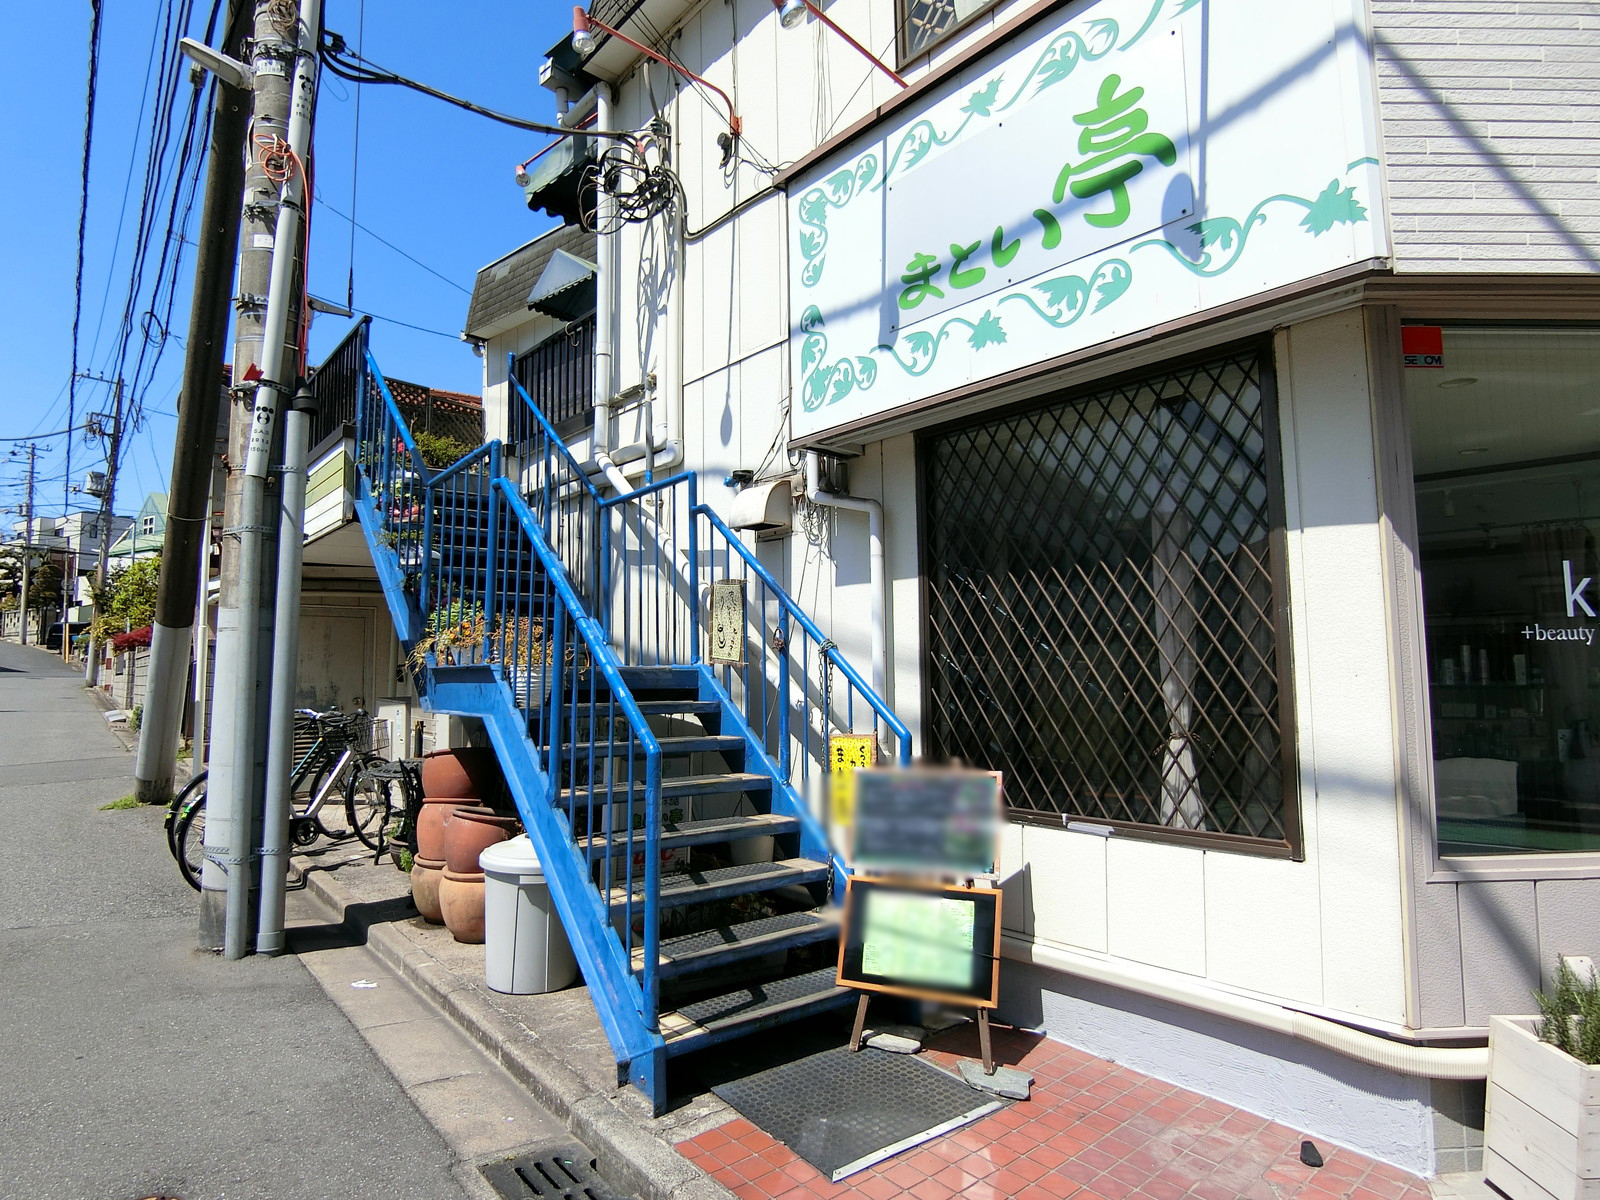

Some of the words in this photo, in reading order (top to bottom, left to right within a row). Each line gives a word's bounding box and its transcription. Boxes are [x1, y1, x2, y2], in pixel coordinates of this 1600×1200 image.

[899, 73, 1177, 310] まとい亭
[1562, 559, 1597, 618] k
[1521, 623, 1596, 646] +beauty
